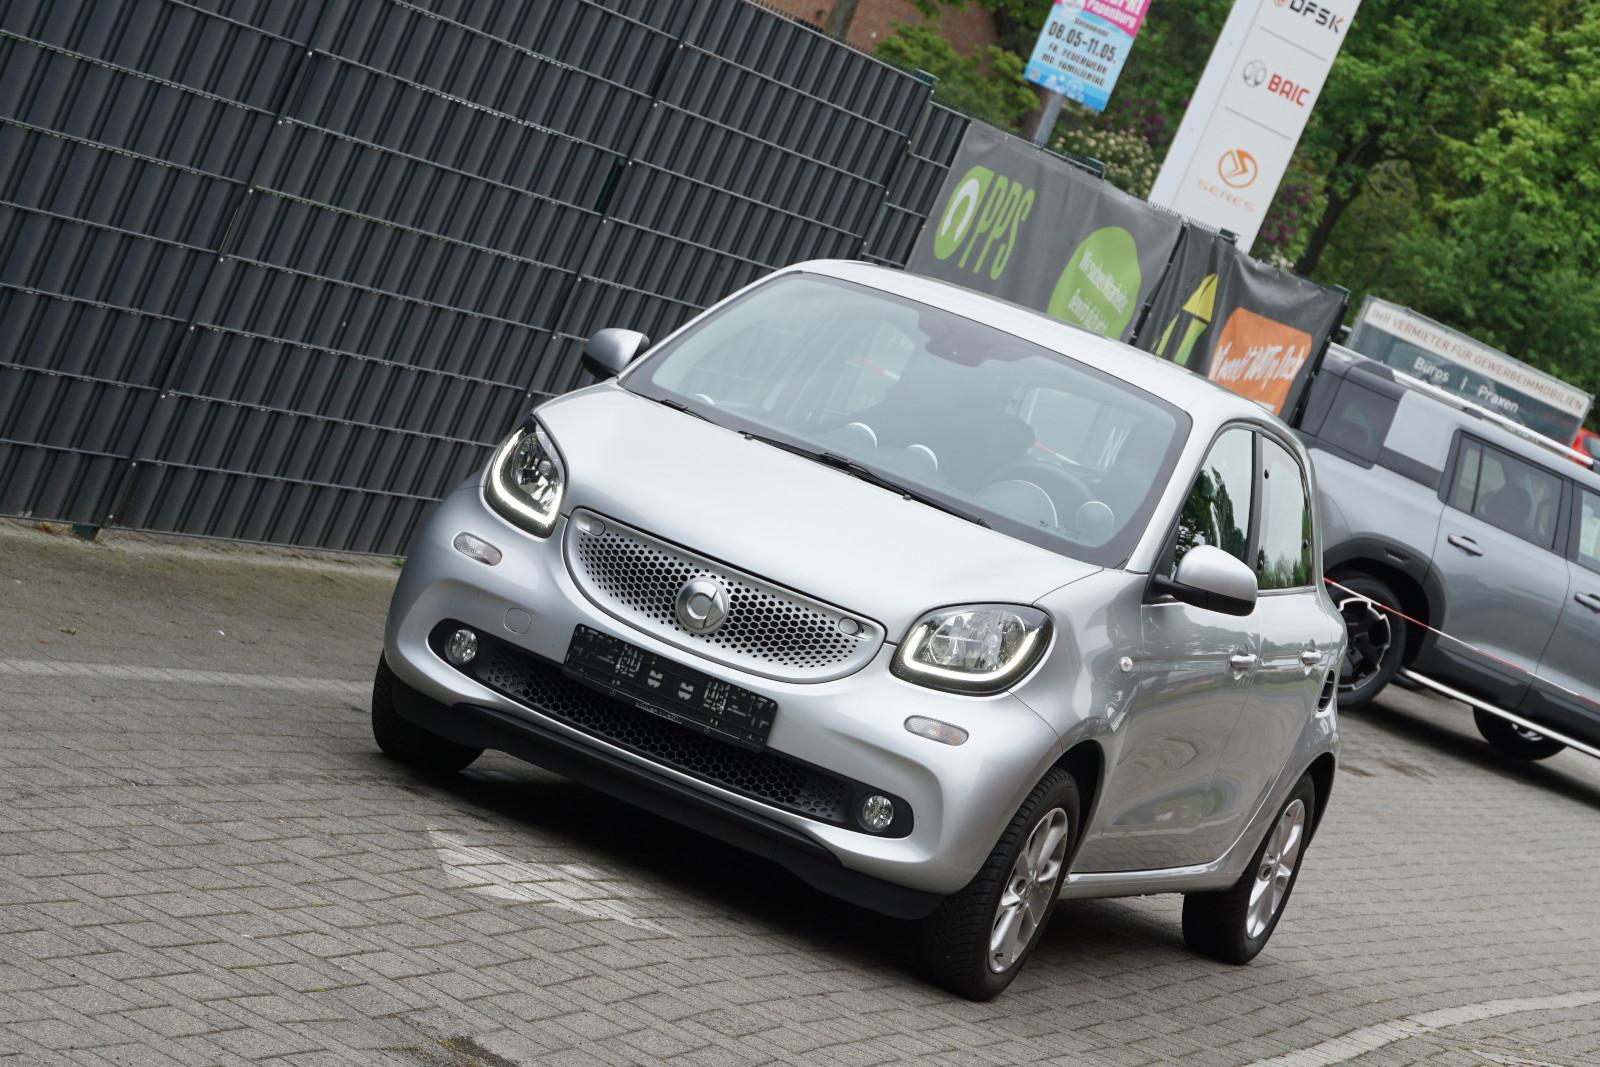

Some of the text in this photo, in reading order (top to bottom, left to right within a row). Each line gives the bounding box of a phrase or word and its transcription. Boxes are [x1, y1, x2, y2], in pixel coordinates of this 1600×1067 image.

[1267, 73, 1310, 107] BAIC
[1392, 318, 1450, 350] VERMIETER
[1412, 355, 1520, 414] Büros Praxen
